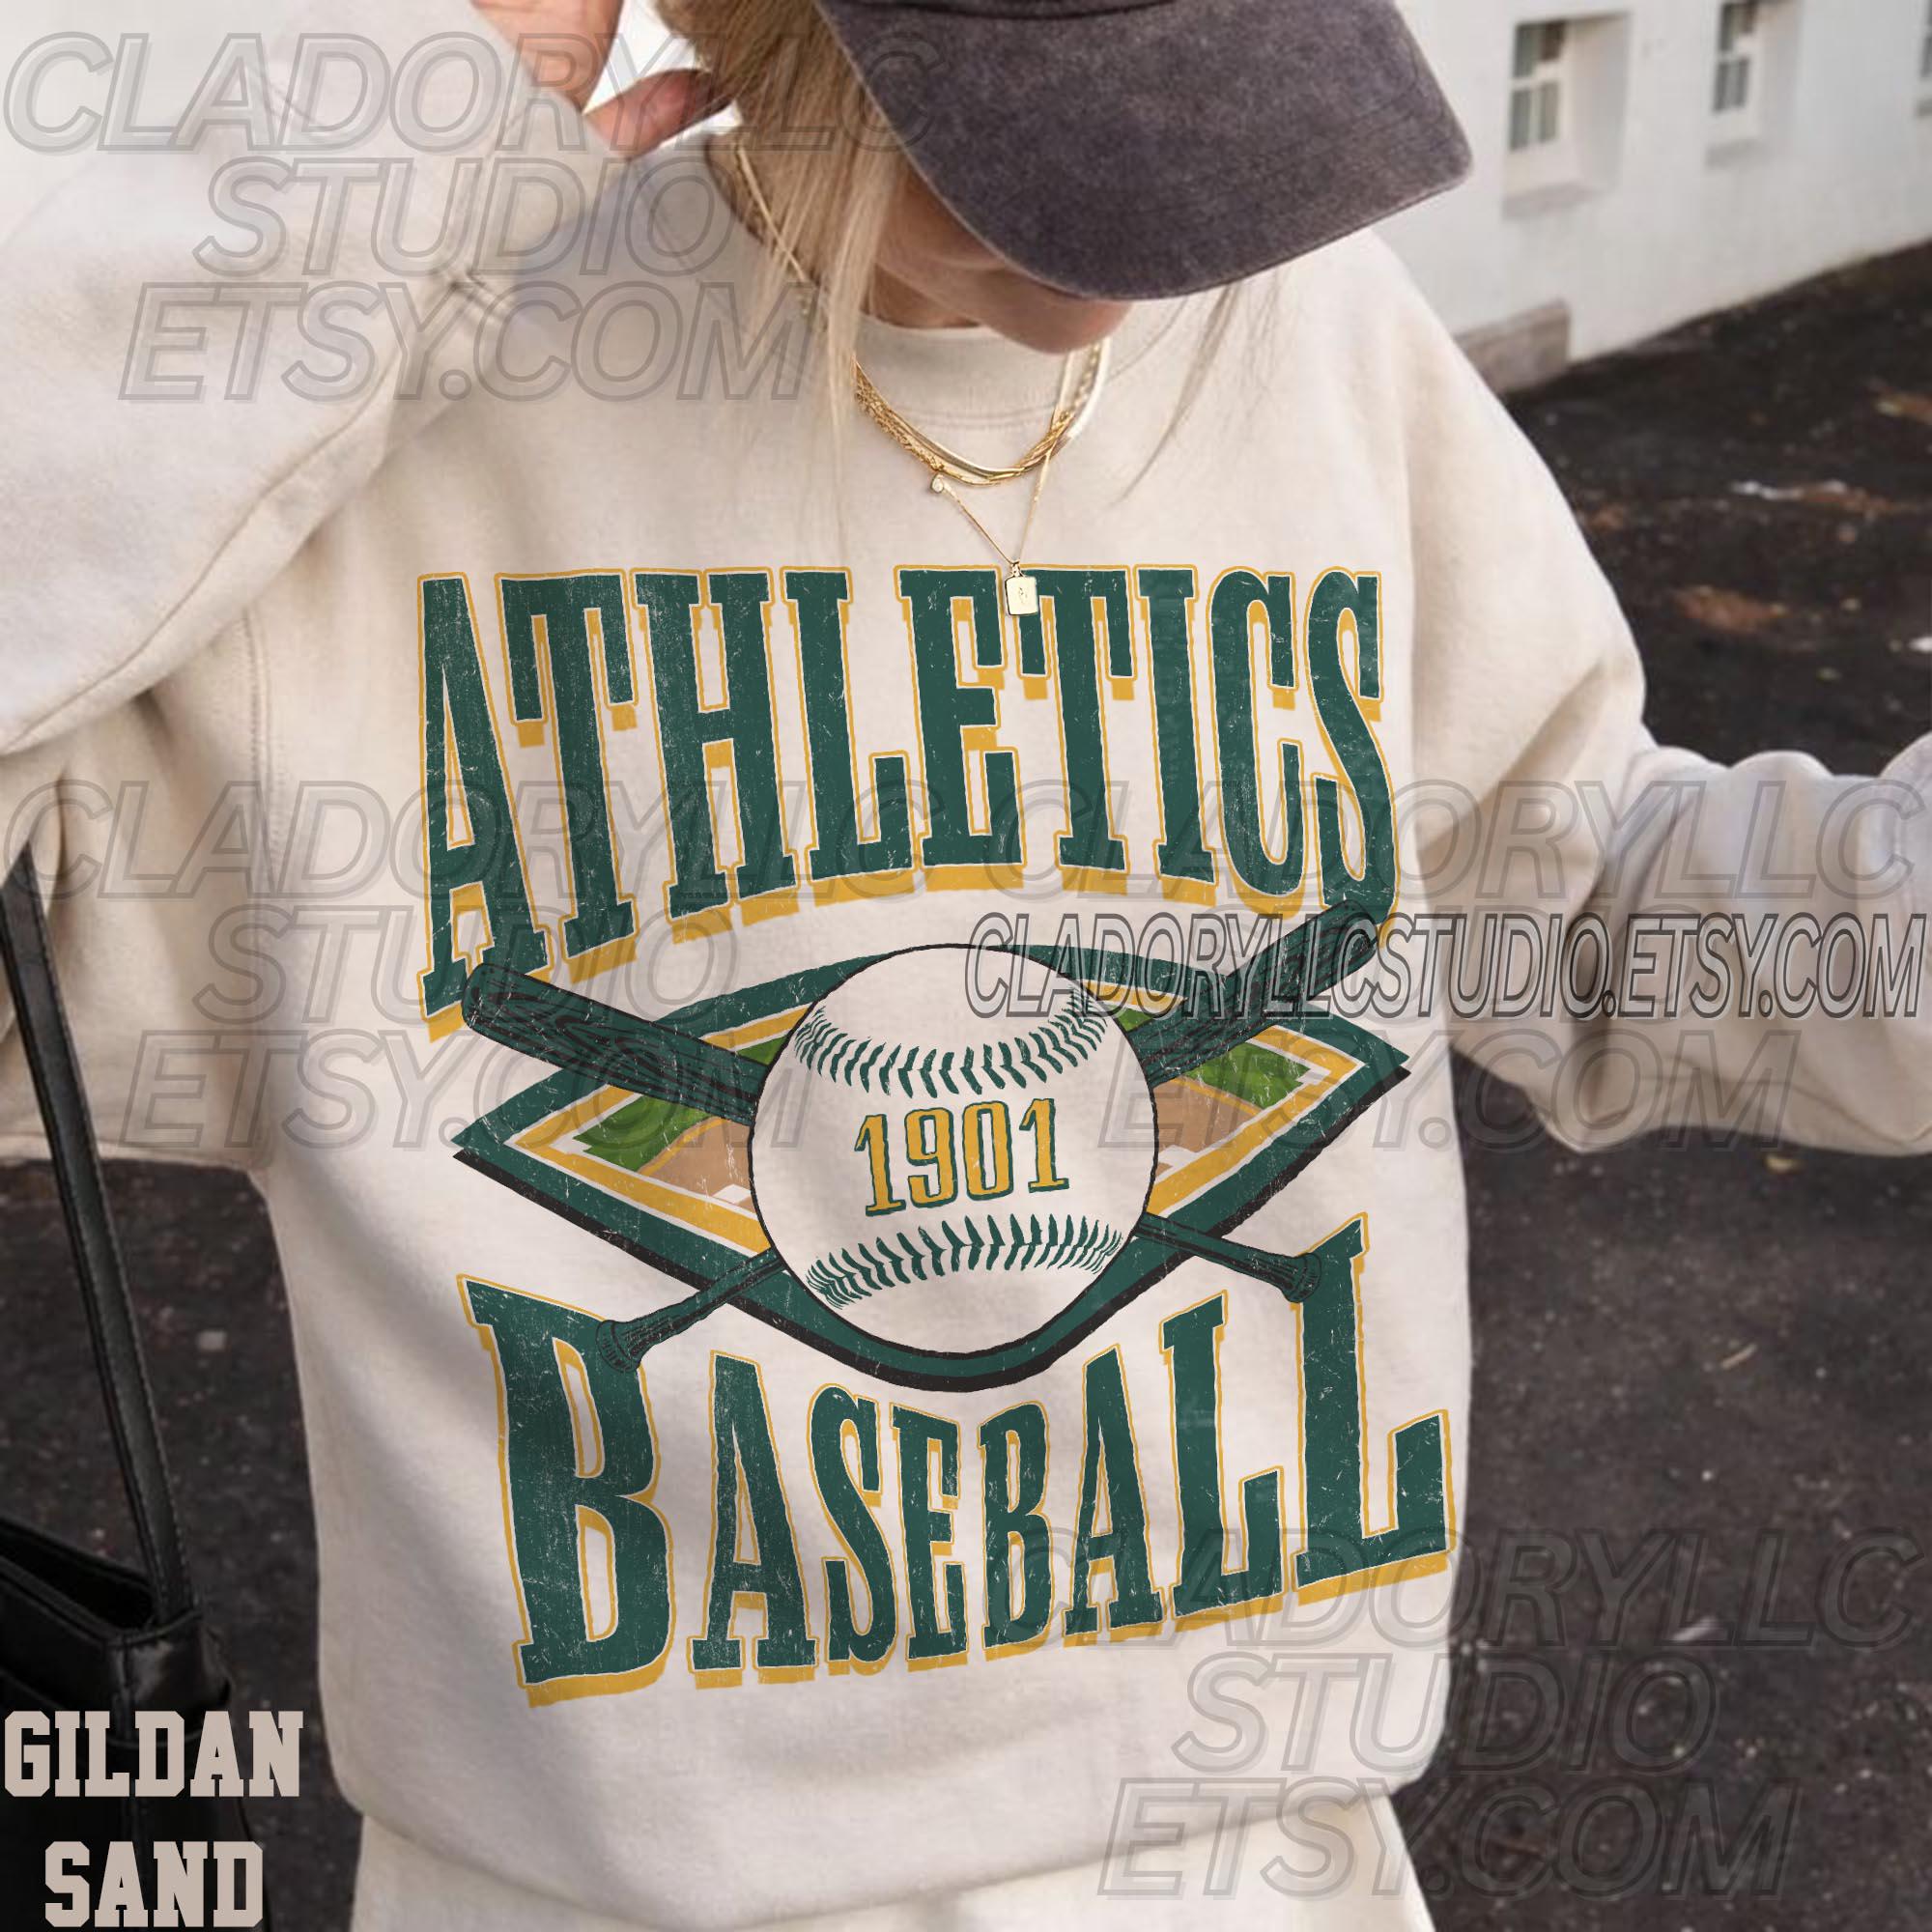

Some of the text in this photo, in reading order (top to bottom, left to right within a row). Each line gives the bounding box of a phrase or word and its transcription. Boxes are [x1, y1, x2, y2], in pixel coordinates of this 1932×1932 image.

[419, 565, 1397, 1041] ATHLETICS
[854, 1098, 1069, 1216] 1901
[456, 1213, 1455, 1706] BASEBALL
